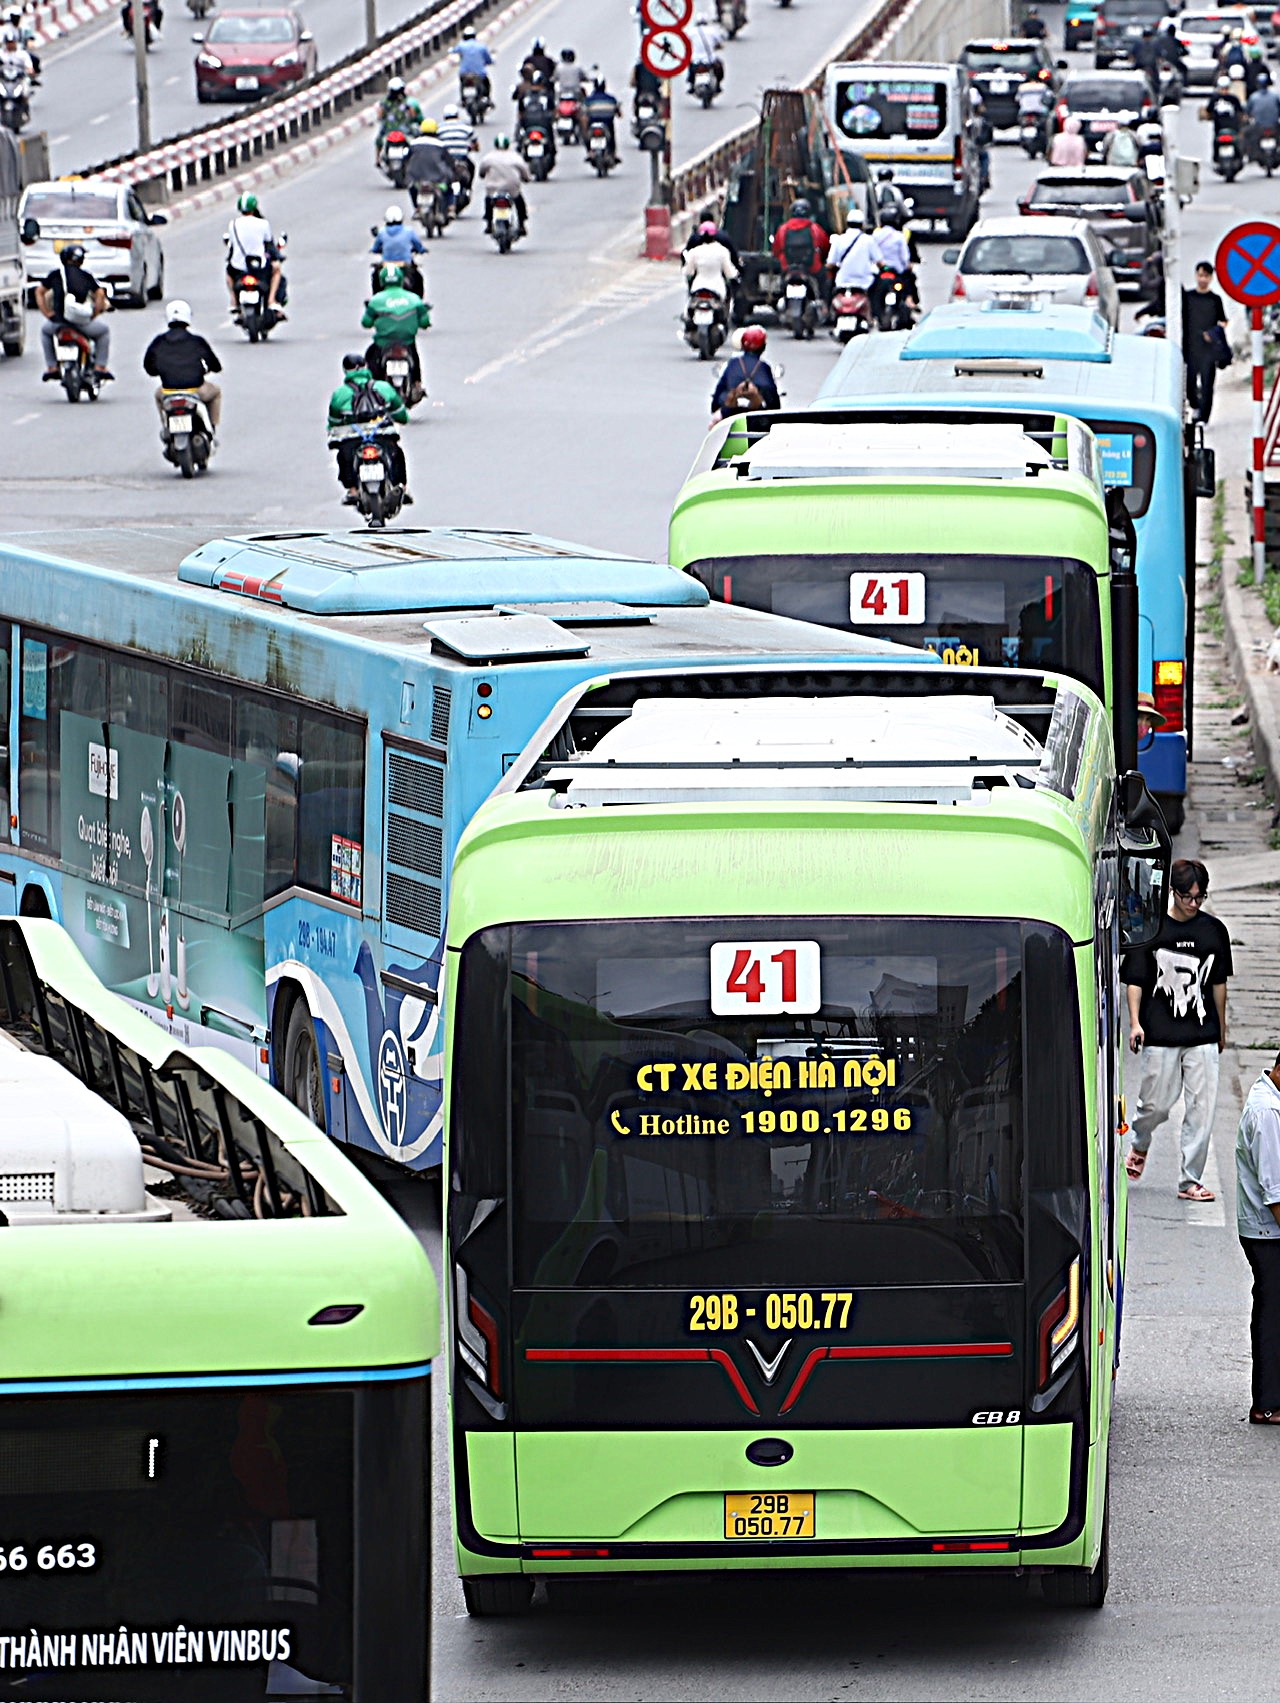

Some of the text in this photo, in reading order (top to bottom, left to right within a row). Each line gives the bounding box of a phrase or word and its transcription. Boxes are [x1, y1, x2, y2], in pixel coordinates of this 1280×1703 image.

[861, 579, 909, 616] 41
[78, 814, 96, 850] Quạt
[726, 949, 797, 1003] 41
[636, 1053, 896, 1097] CT XE ĐIỆN HÀ NỘI
[639, 1107, 912, 1136] Hotline 1900.1296
[689, 1294, 738, 1330] 29B
[765, 1292, 853, 1330] 050.77
[750, 1495, 789, 1515] 29B
[734, 1516, 805, 1537] 050.77
[36, 1543, 96, 1569] 663
[0, 1624, 291, 1668] THÀNH NHÂN VIÊN VINBUS
